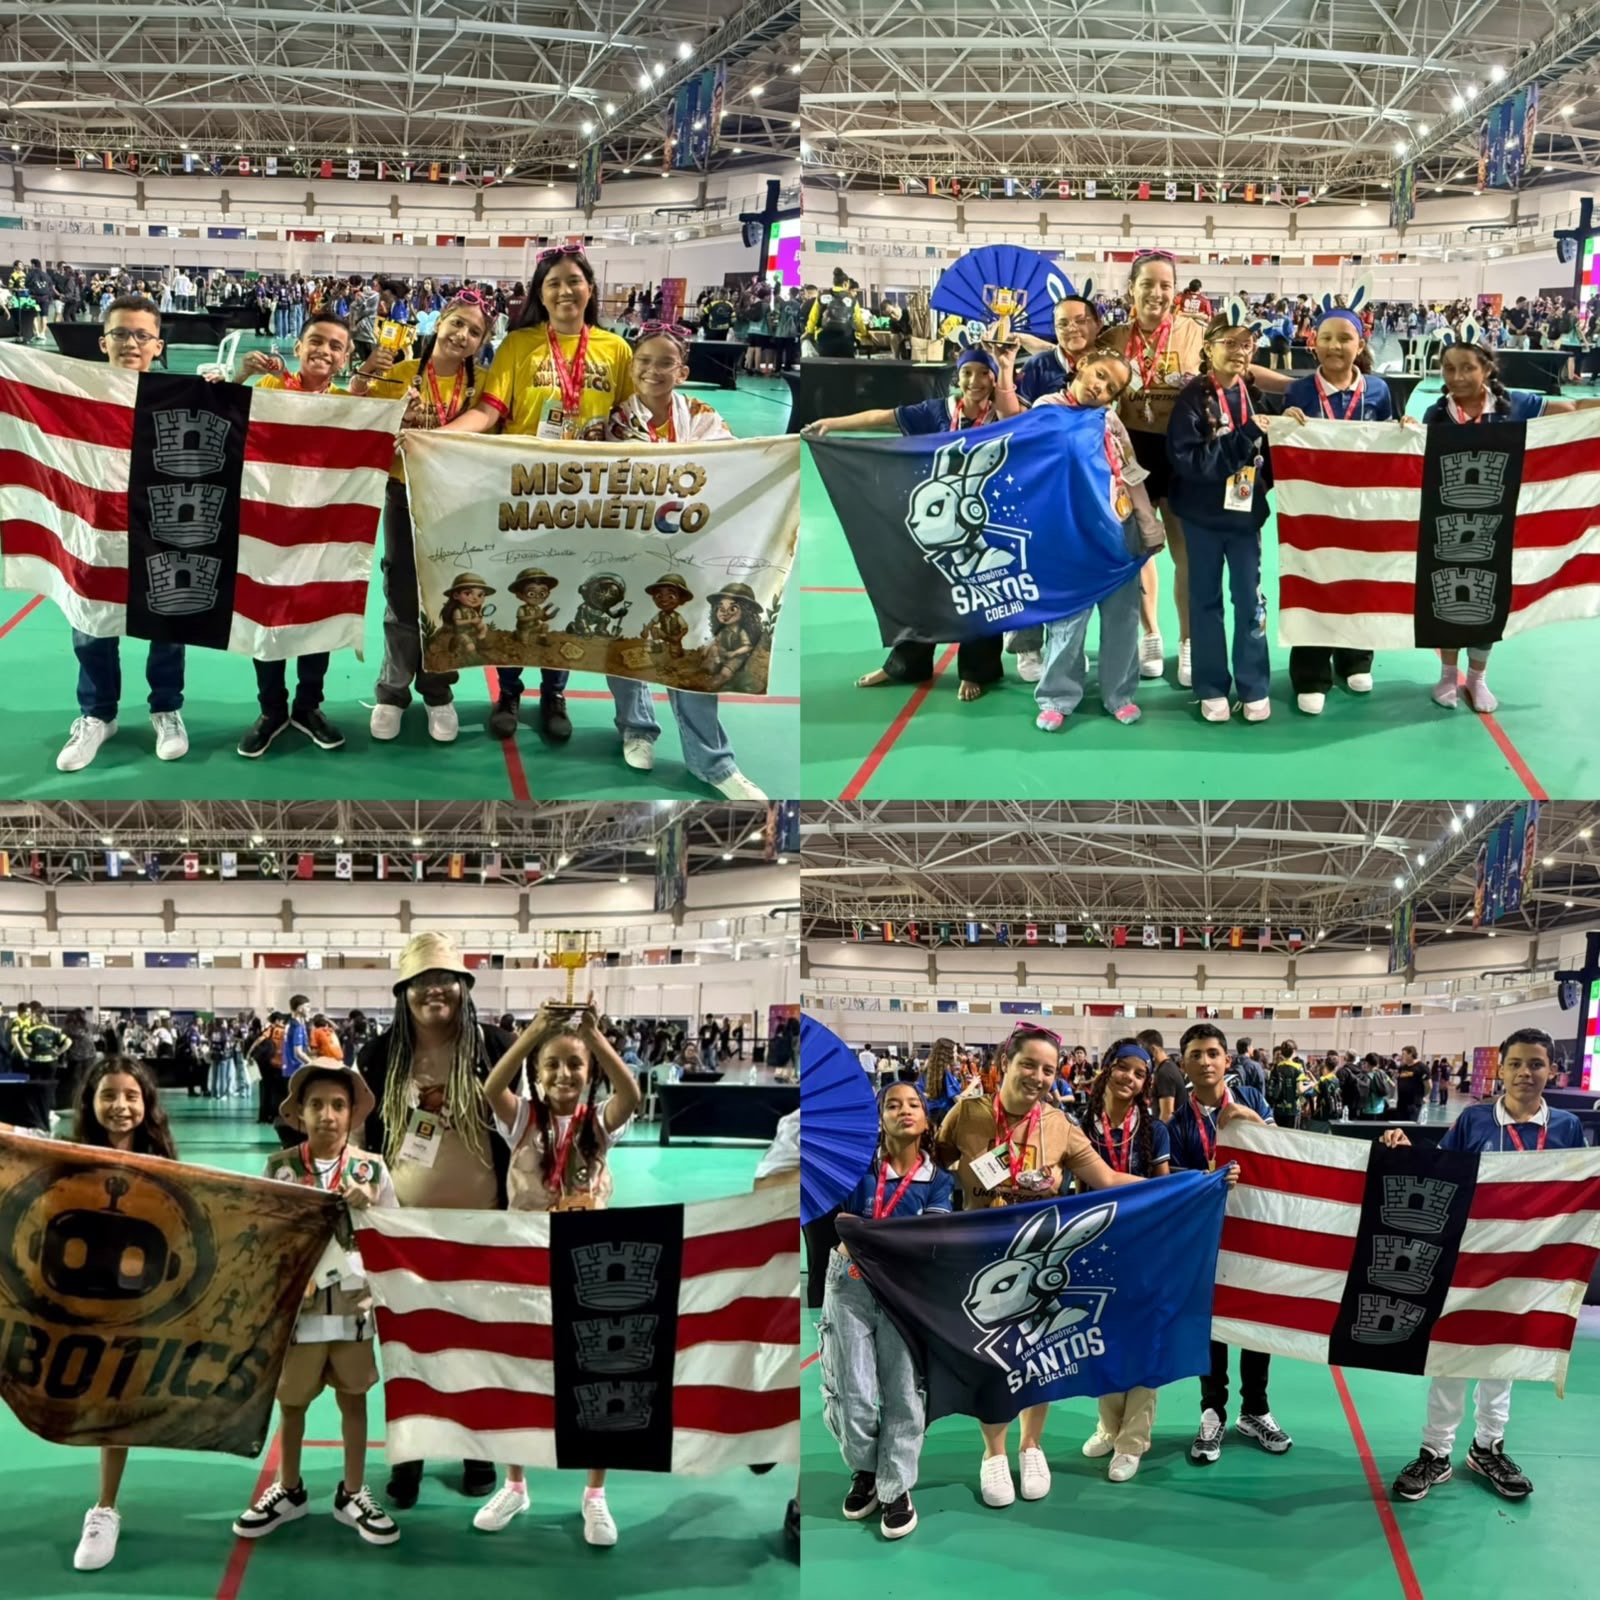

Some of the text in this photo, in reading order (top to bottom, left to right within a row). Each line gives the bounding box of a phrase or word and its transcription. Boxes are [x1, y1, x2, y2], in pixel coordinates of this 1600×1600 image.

[511, 458, 707, 498] MISTÉRIO
[498, 495, 710, 534] MAGNÉTICO
[951, 573, 1040, 615] SANTOS
[985, 600, 1024, 622] COELHO
[0, 1319, 269, 1402] BOTICS
[1006, 1326, 1105, 1394] SANTOS
[1021, 1325, 1078, 1361] LIGA DE ROBÓTICA
